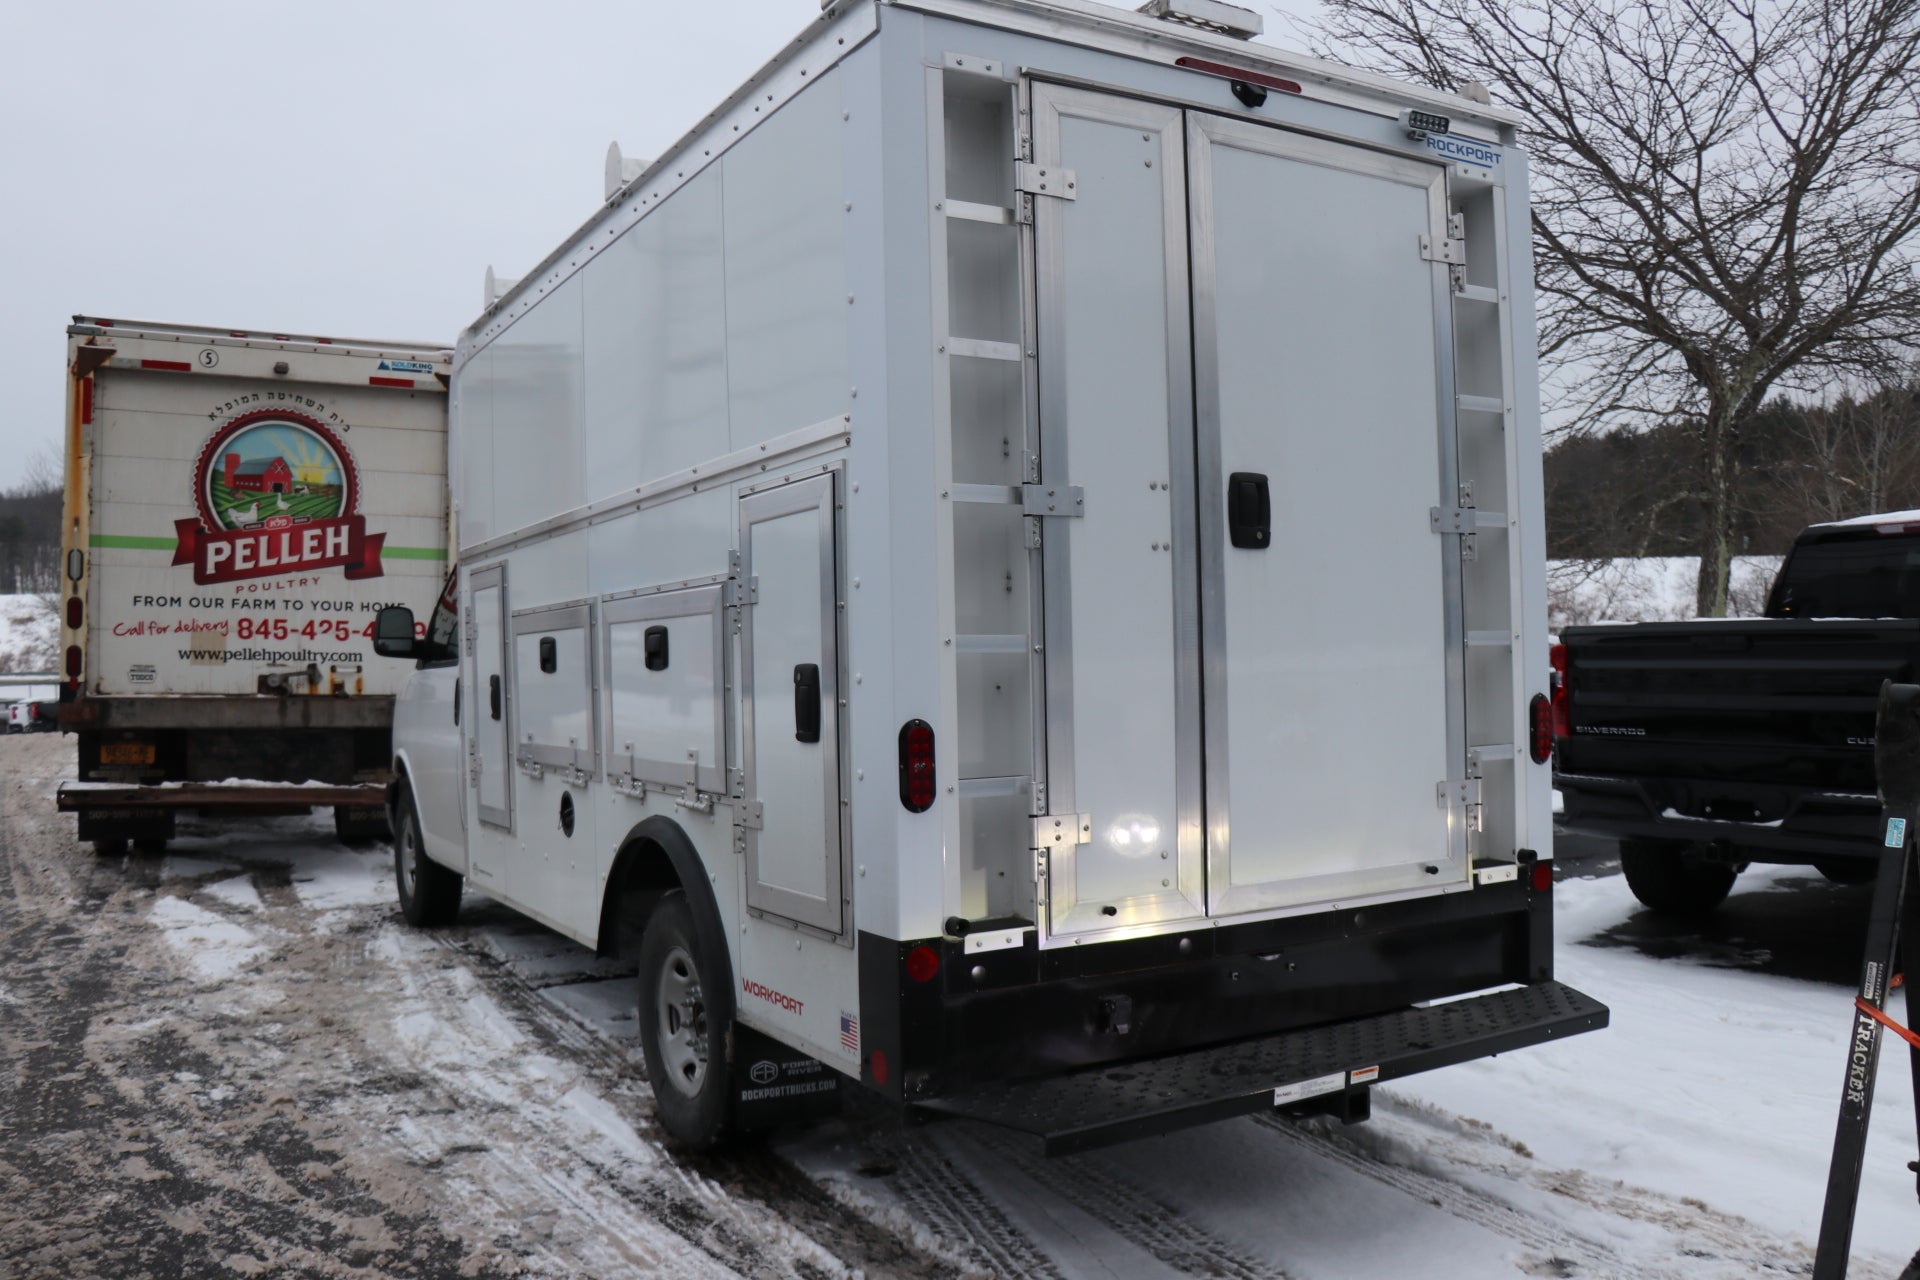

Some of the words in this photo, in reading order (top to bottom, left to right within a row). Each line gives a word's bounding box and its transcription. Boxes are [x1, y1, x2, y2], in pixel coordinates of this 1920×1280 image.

[1426, 137, 1502, 164] ROCKPORT
[206, 352, 212, 365] 5
[208, 393, 260, 421] המופלא
[267, 392, 325, 413] השחיטה
[329, 412, 351, 432] בית
[206, 525, 350, 575] PELLEH
[236, 576, 321, 594] POULTRY
[133, 595, 182, 607] FROM
[189, 597, 225, 608] OUR
[231, 598, 276, 610] FARM
[283, 600, 304, 611] TO
[311, 601, 354, 612] YOUR
[113, 619, 145, 637] Call
[148, 620, 170, 636] for
[174, 618, 229, 637] delivery
[238, 617, 427, 641] 845-425-49
[178, 648, 363, 664] www.pellehpoultry.com
[1575, 725, 1647, 736] SILVERADO
[1847, 737, 1875, 745] CUS
[742, 977, 805, 1016] WORKPORT
[782, 1060, 822, 1069] FORES
[1847, 1014, 1876, 1103] TRACKER
[787, 1066, 822, 1076] RIVER
[741, 1080, 837, 1101] ROCKPORTTRUCKS.COM
